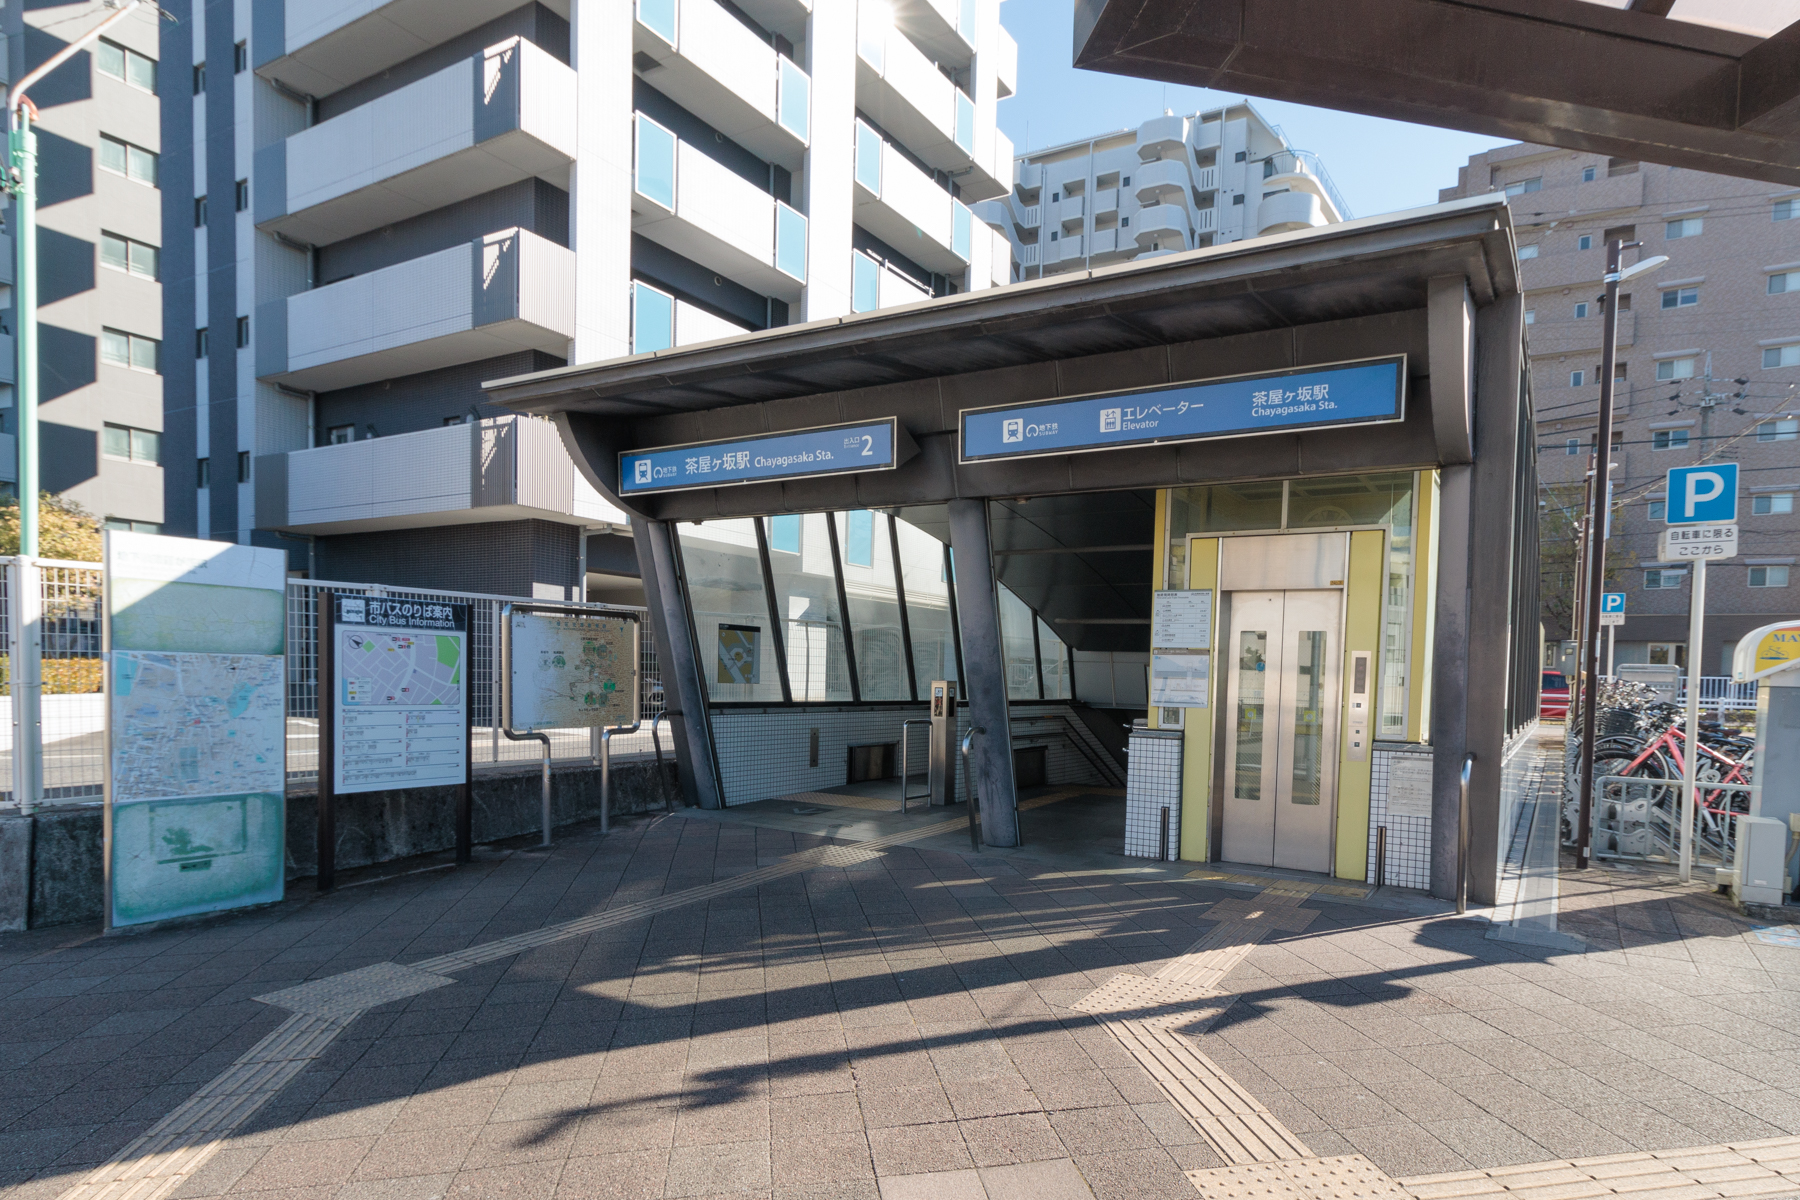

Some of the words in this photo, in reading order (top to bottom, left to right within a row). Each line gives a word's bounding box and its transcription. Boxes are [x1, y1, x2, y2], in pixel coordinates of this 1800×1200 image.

[1252, 384, 1329, 407] 茶屋ヶ坂駅
[1123, 401, 1204, 420] エレベーター
[1252, 403, 1317, 417] Chayagasaka
[1319, 401, 1338, 411] Sta.
[1039, 422, 1059, 432] 地下鉄
[1123, 419, 1160, 431] Elevator
[861, 434, 873, 457] 2
[685, 451, 750, 475] 茶屋ヶ坂駅
[754, 451, 814, 468] Chayagasaka
[816, 449, 834, 461] Sta.
[1684, 471, 1725, 518] P
[1670, 528, 1734, 541] 自転車に限る
[1679, 544, 1724, 556] ここから
[369, 601, 453, 620] 市バスのりば案内
[1606, 594, 1621, 612] P
[369, 614, 387, 626] City
[389, 616, 407, 625] Bus
[408, 617, 455, 628] Information
